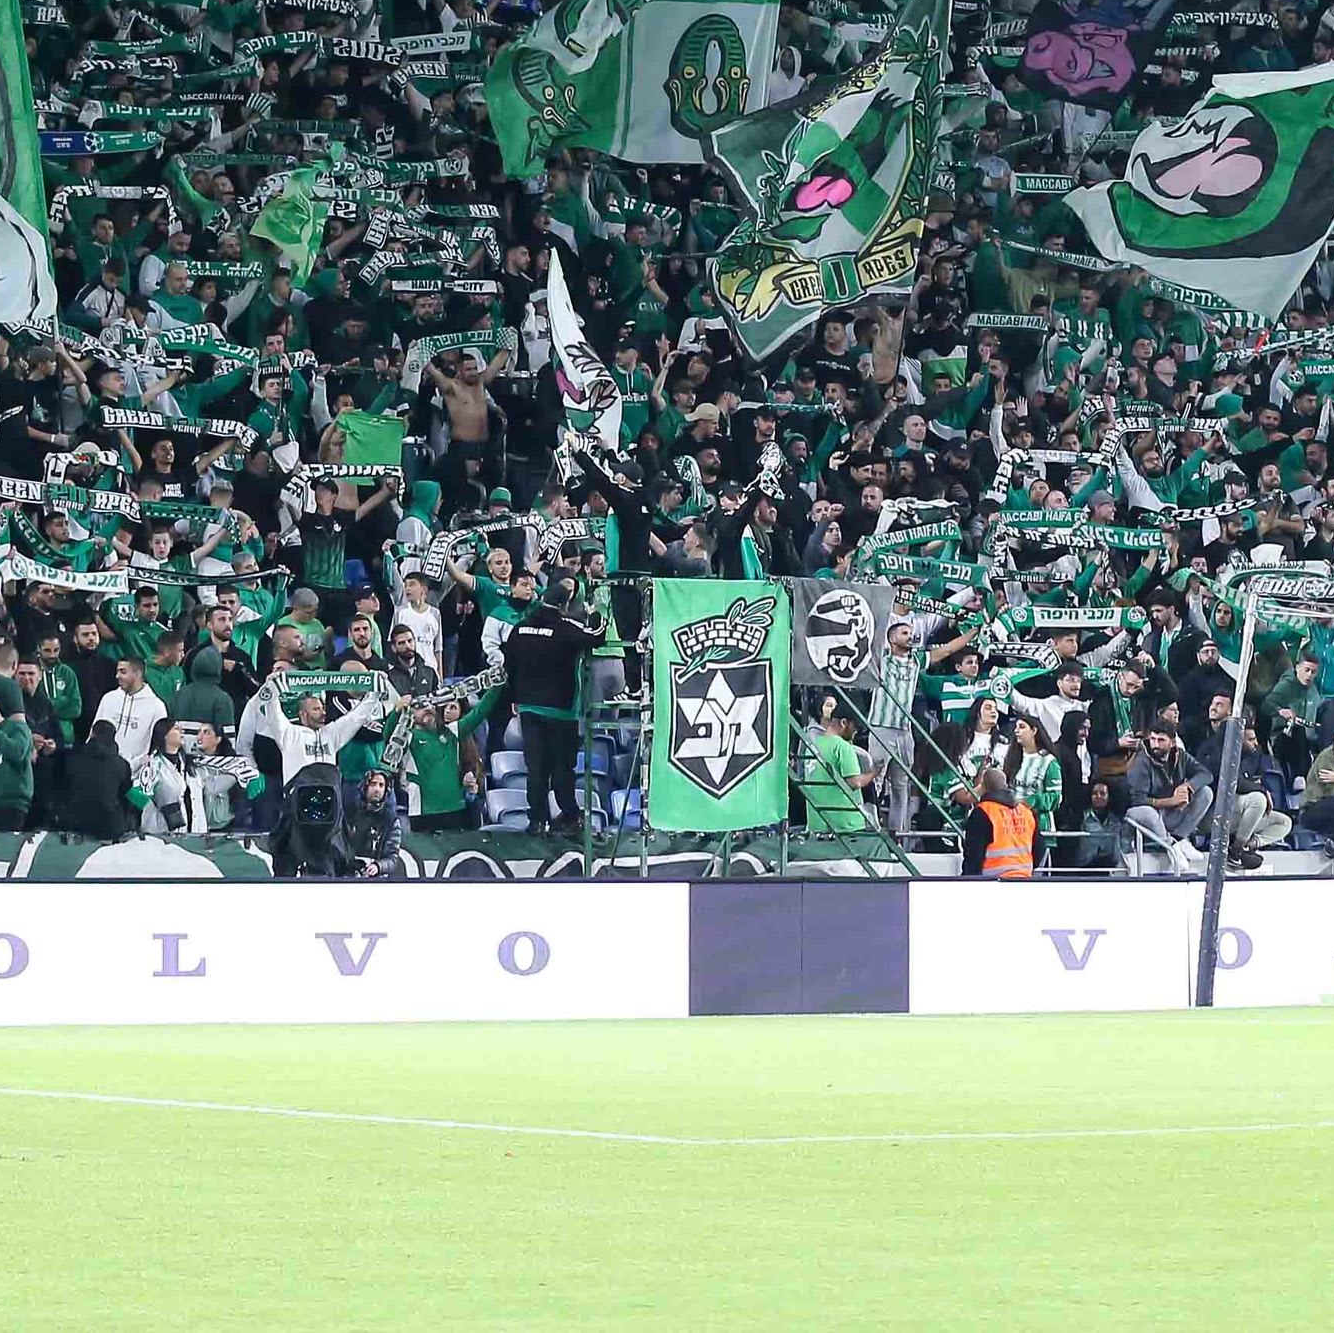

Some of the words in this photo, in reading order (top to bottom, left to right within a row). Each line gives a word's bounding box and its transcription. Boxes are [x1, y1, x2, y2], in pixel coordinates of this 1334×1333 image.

[279, 29, 316, 45] מכבי
[432, 32, 466, 48] מכבי
[1023, 175, 1071, 191] MACCABI
[866, 246, 910, 281] APES
[410, 278, 439, 291] HAIFA
[462, 279, 486, 291] CITY
[1171, 285, 1209, 308] חיפה
[974, 314, 1023, 327] MACCABI
[101, 406, 162, 428] GREEN
[1043, 510, 1072, 522] HAIFA
[1073, 510, 1087, 522] FC
[862, 530, 907, 555] MACCABI
[906, 525, 939, 541] HAIFA
[877, 553, 915, 573] חיפה
[940, 561, 971, 580] מכבי
[1038, 608, 1078, 620] חיפה
[1081, 607, 1114, 620] מכבי
[288, 674, 327, 686] MACCABI
[328, 674, 356, 685] HAIFA
[358, 673, 372, 685] FC
